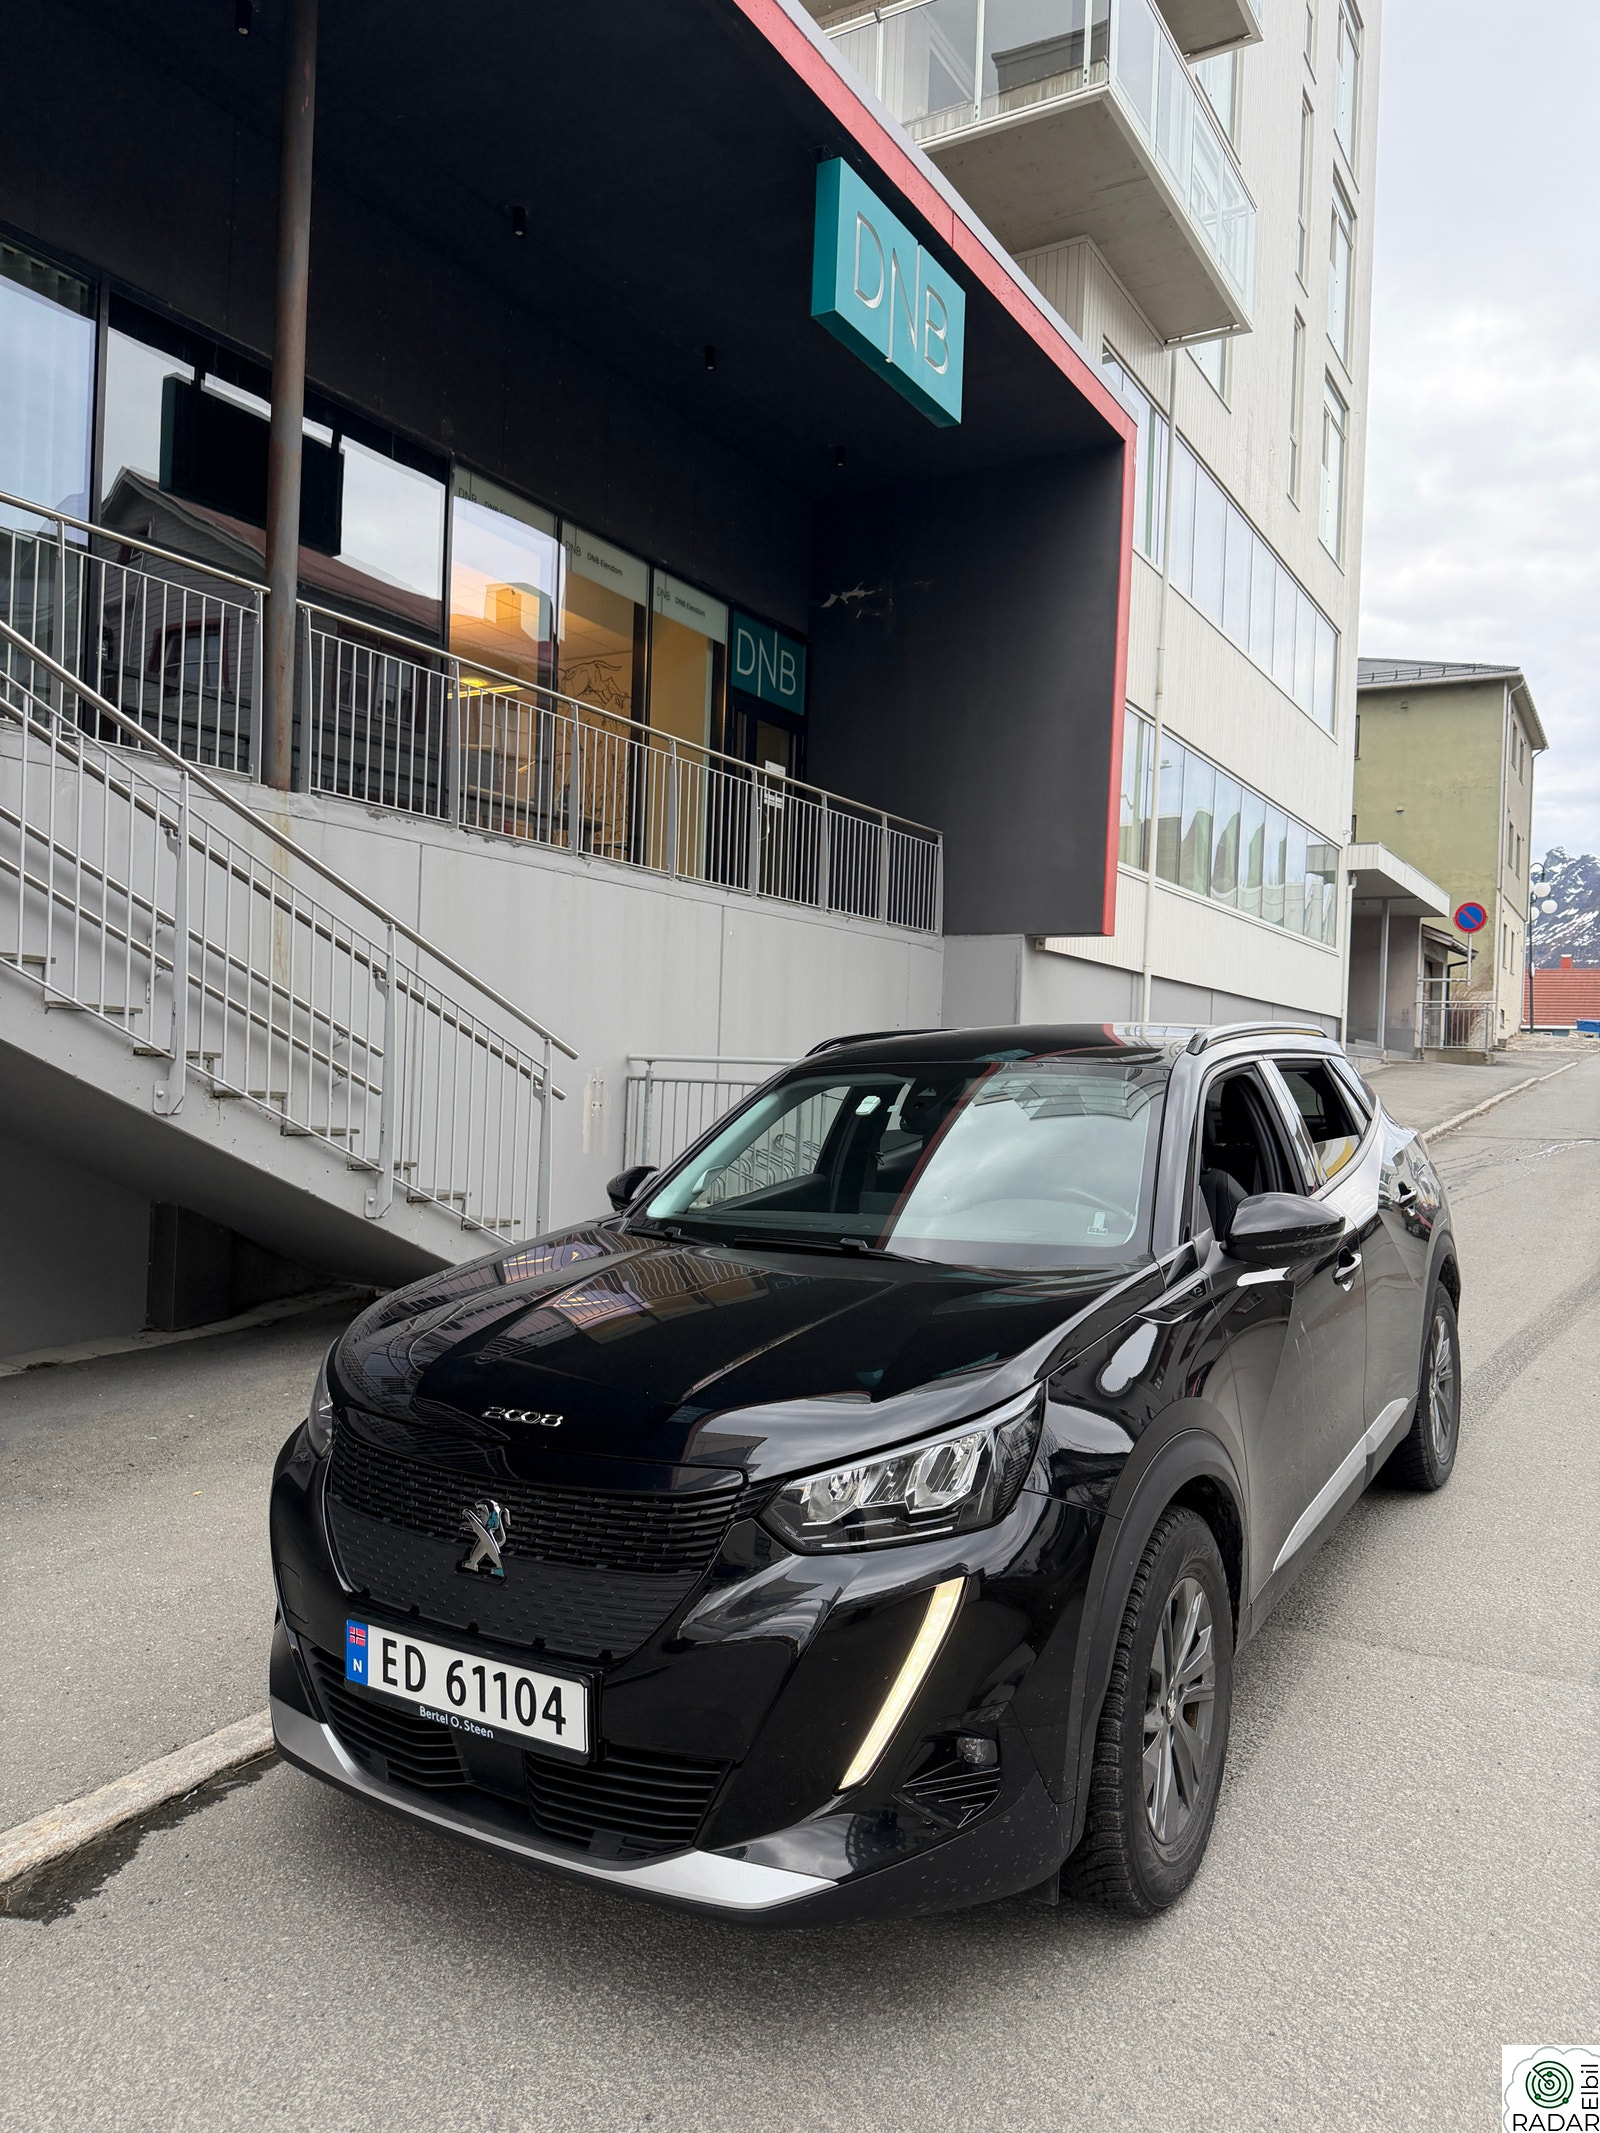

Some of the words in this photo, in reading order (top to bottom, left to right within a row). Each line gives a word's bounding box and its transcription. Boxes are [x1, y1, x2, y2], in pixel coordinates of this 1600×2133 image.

[854, 210, 949, 375] DNB
[586, 552, 600, 565] DNB
[600, 559, 623, 576] Eiendom
[736, 628, 797, 697] DNB
[481, 1406, 564, 1427] 2008
[353, 1658, 362, 1673] N
[382, 1637, 426, 1693] ED
[446, 1659, 567, 1736] 61104
[419, 1705, 449, 1725] Bertel
[450, 1716, 463, 1730] O.
[463, 1720, 494, 1739] Steen
